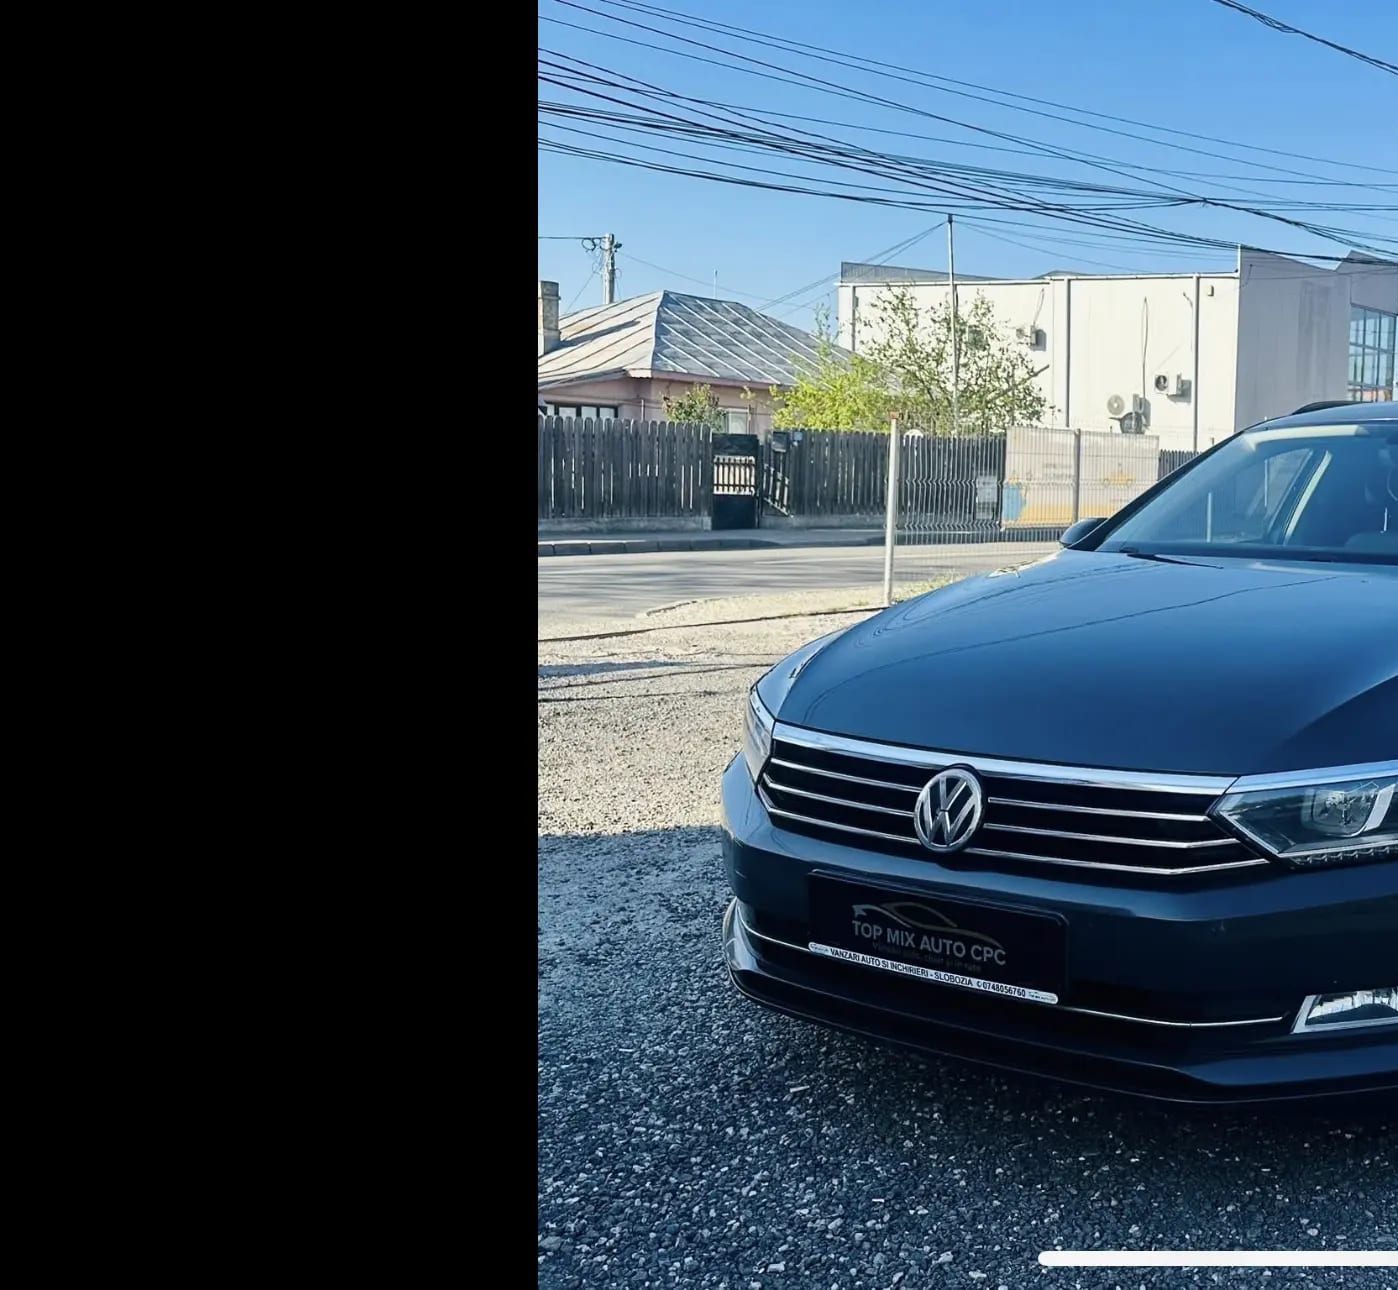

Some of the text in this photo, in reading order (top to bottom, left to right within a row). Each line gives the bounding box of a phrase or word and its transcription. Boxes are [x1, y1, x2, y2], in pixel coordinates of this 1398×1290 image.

[852, 920, 882, 939] TOP
[887, 928, 915, 948] MIX
[920, 935, 966, 957] AUTO
[971, 945, 1006, 965] CPC
[830, 948, 860, 961] VANZARI
[861, 955, 880, 966] AUTO
[881, 960, 889, 968] SI
[934, 971, 973, 987] SLOBOZIA
[983, 981, 1026, 998] 0748056760
